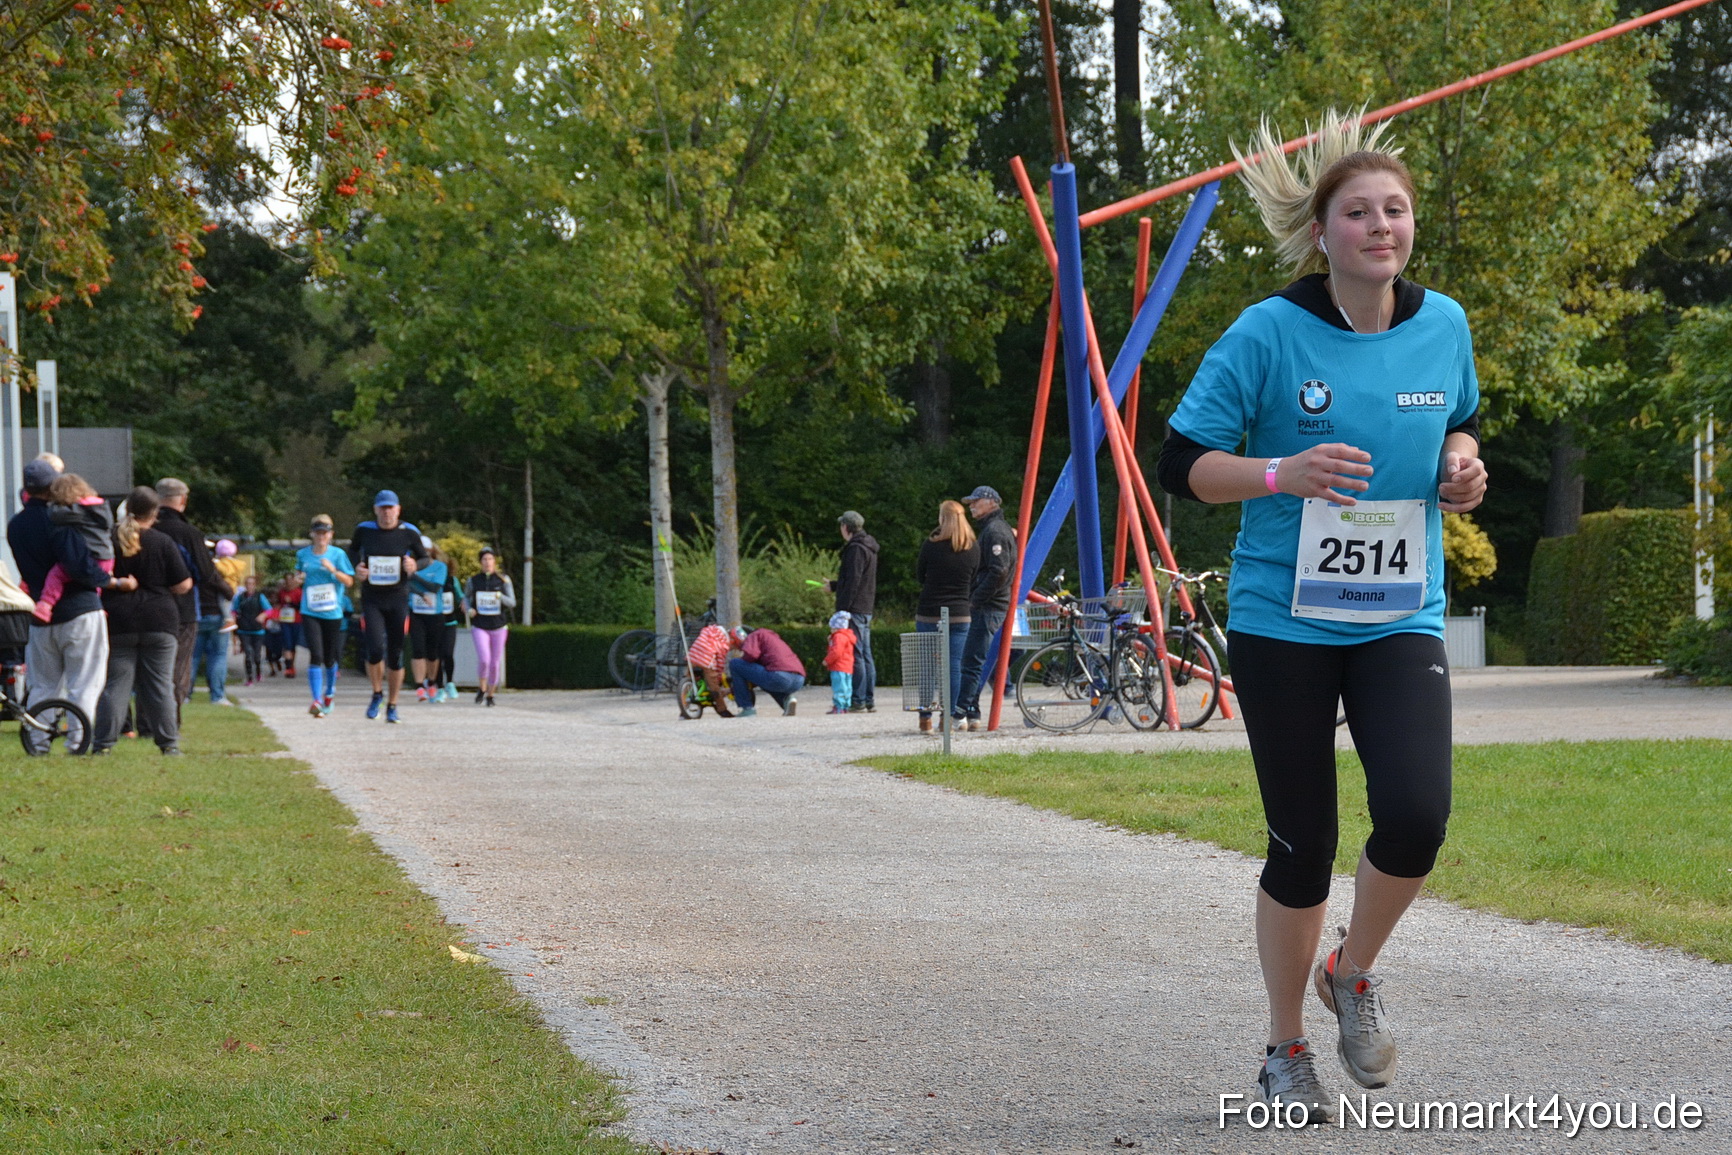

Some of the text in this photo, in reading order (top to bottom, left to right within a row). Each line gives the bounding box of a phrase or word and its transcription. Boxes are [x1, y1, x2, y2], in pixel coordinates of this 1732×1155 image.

[1301, 381, 1330, 392] BMW
[1396, 391, 1447, 407] BOCK
[1298, 420, 1334, 429] PARTL
[1354, 512, 1395, 523] BOCK
[1318, 537, 1408, 575] 2514
[1338, 588, 1385, 602] Joanna
